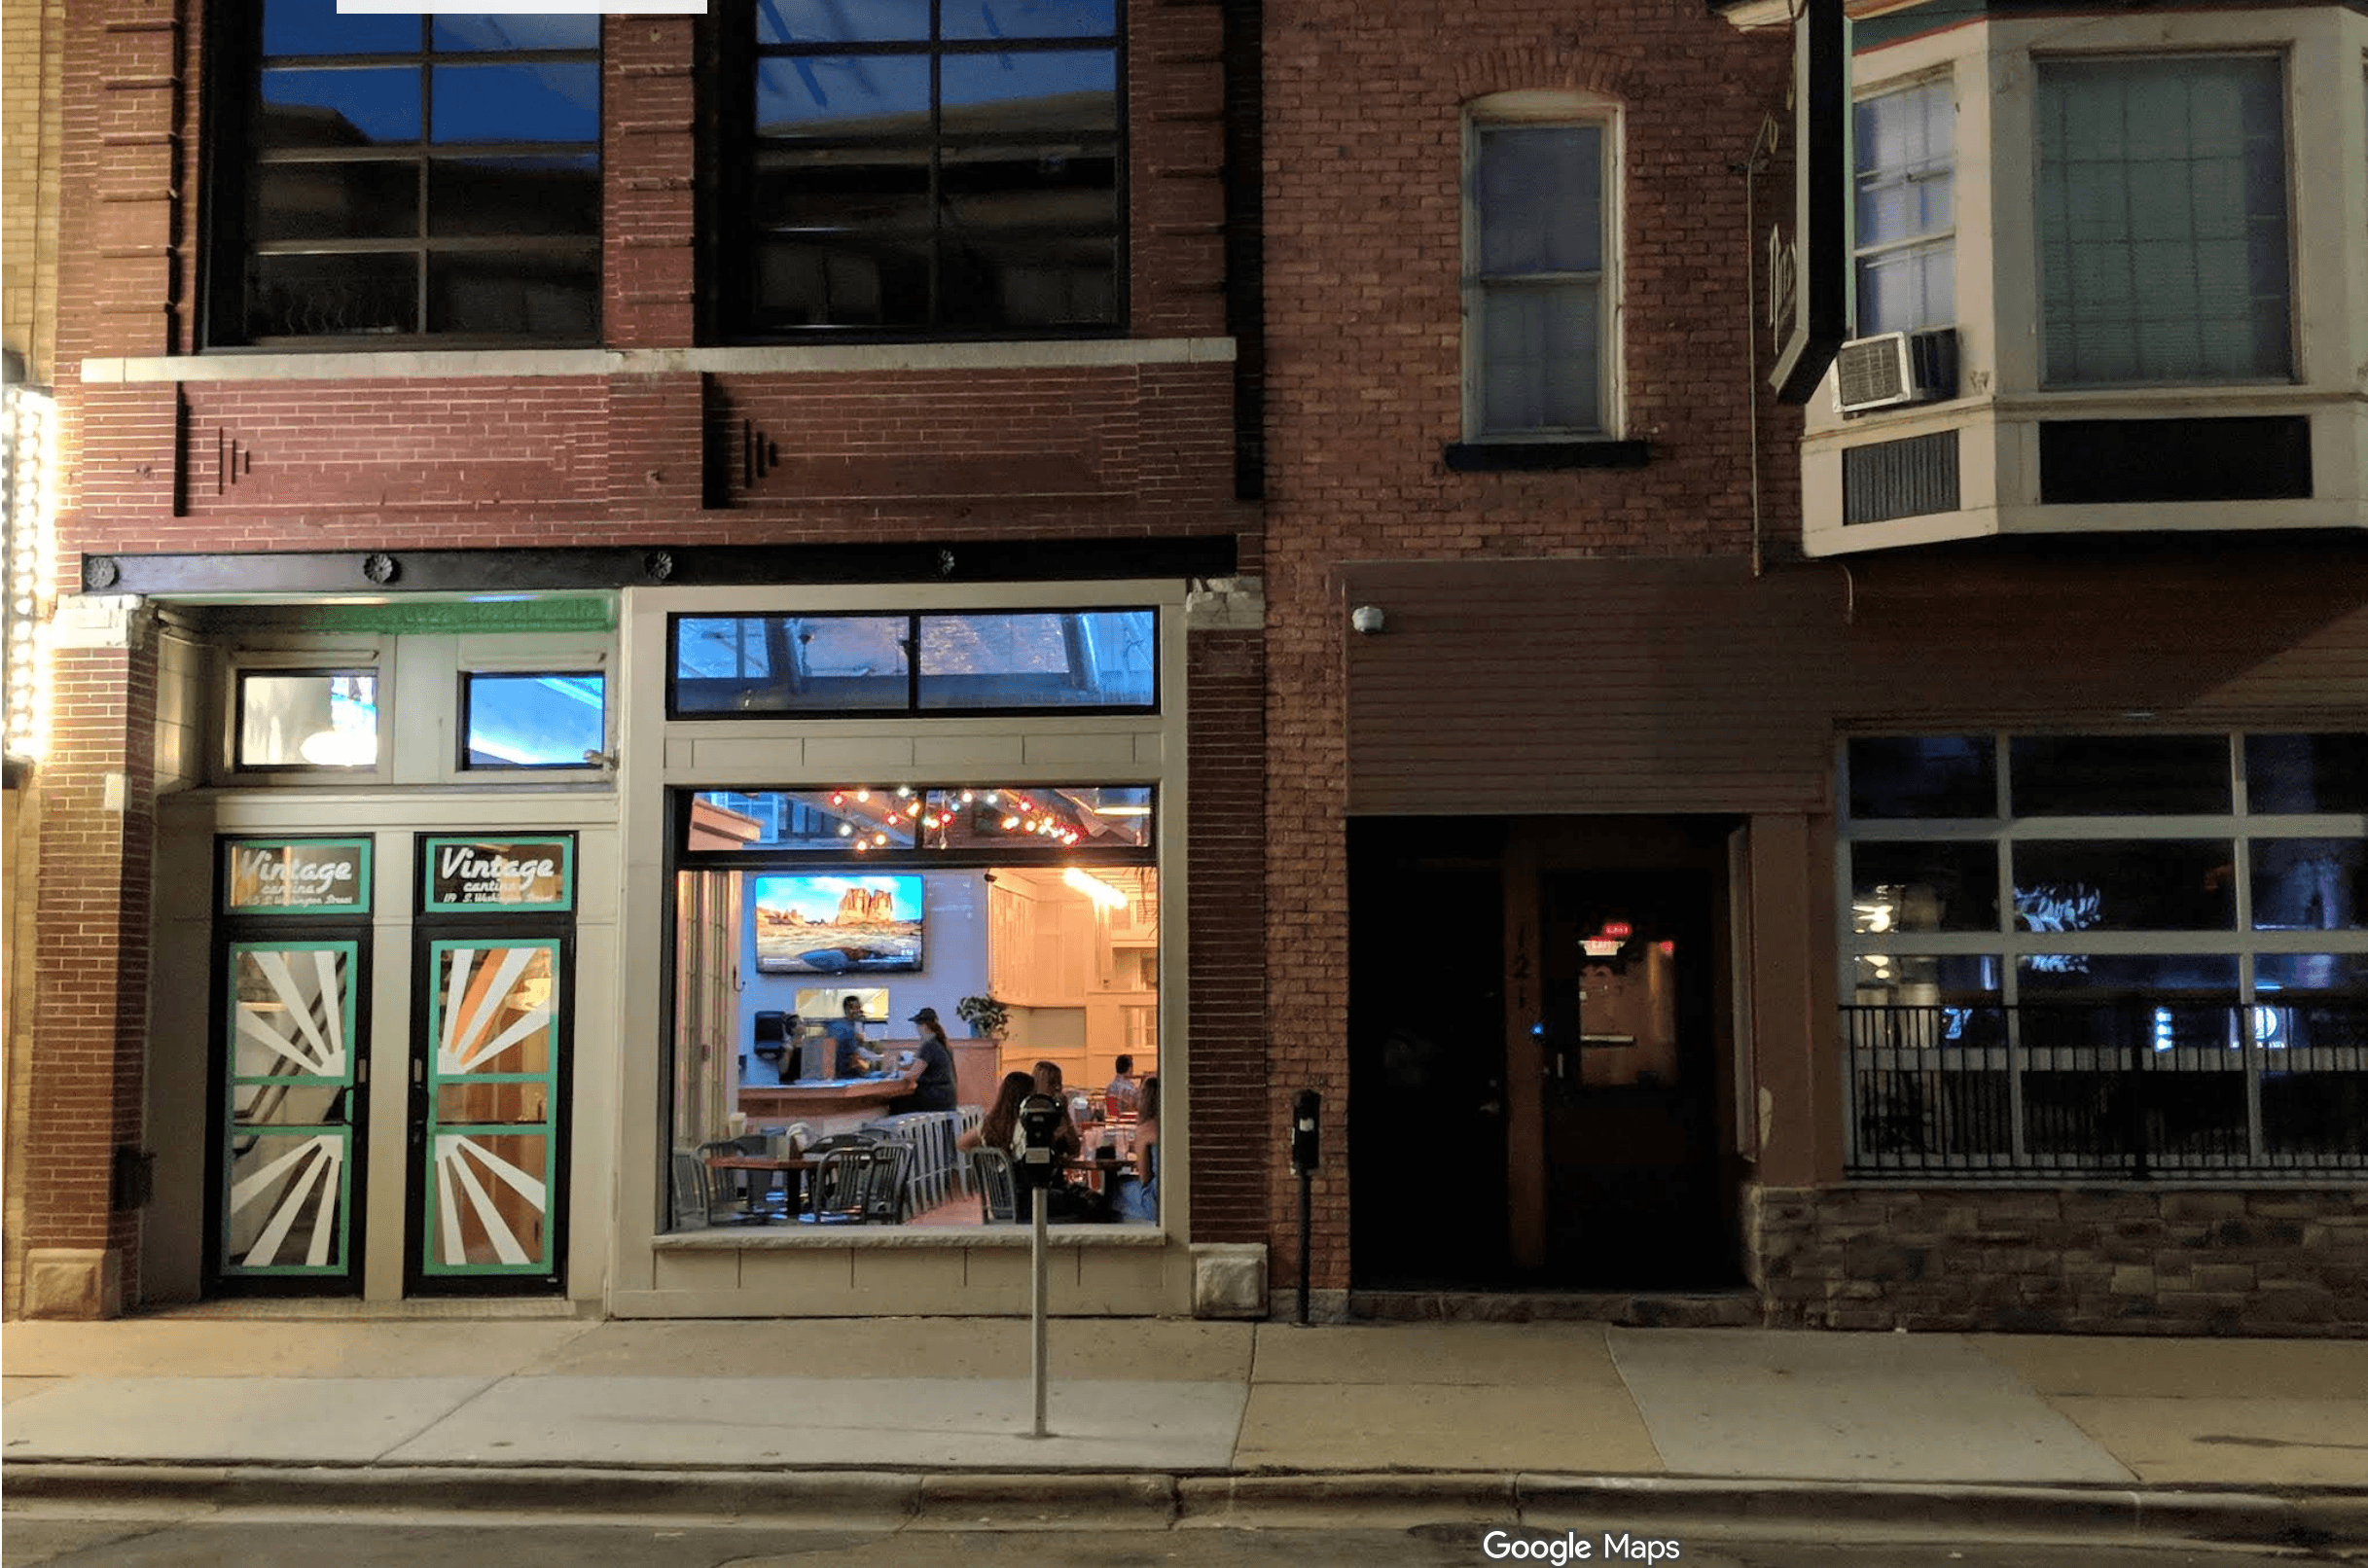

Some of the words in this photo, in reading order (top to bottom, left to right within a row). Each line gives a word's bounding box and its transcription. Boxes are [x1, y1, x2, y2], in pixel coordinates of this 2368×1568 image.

[240, 850, 352, 894] Vintage
[261, 880, 315, 894] canina
[442, 847, 555, 891] Vintage
